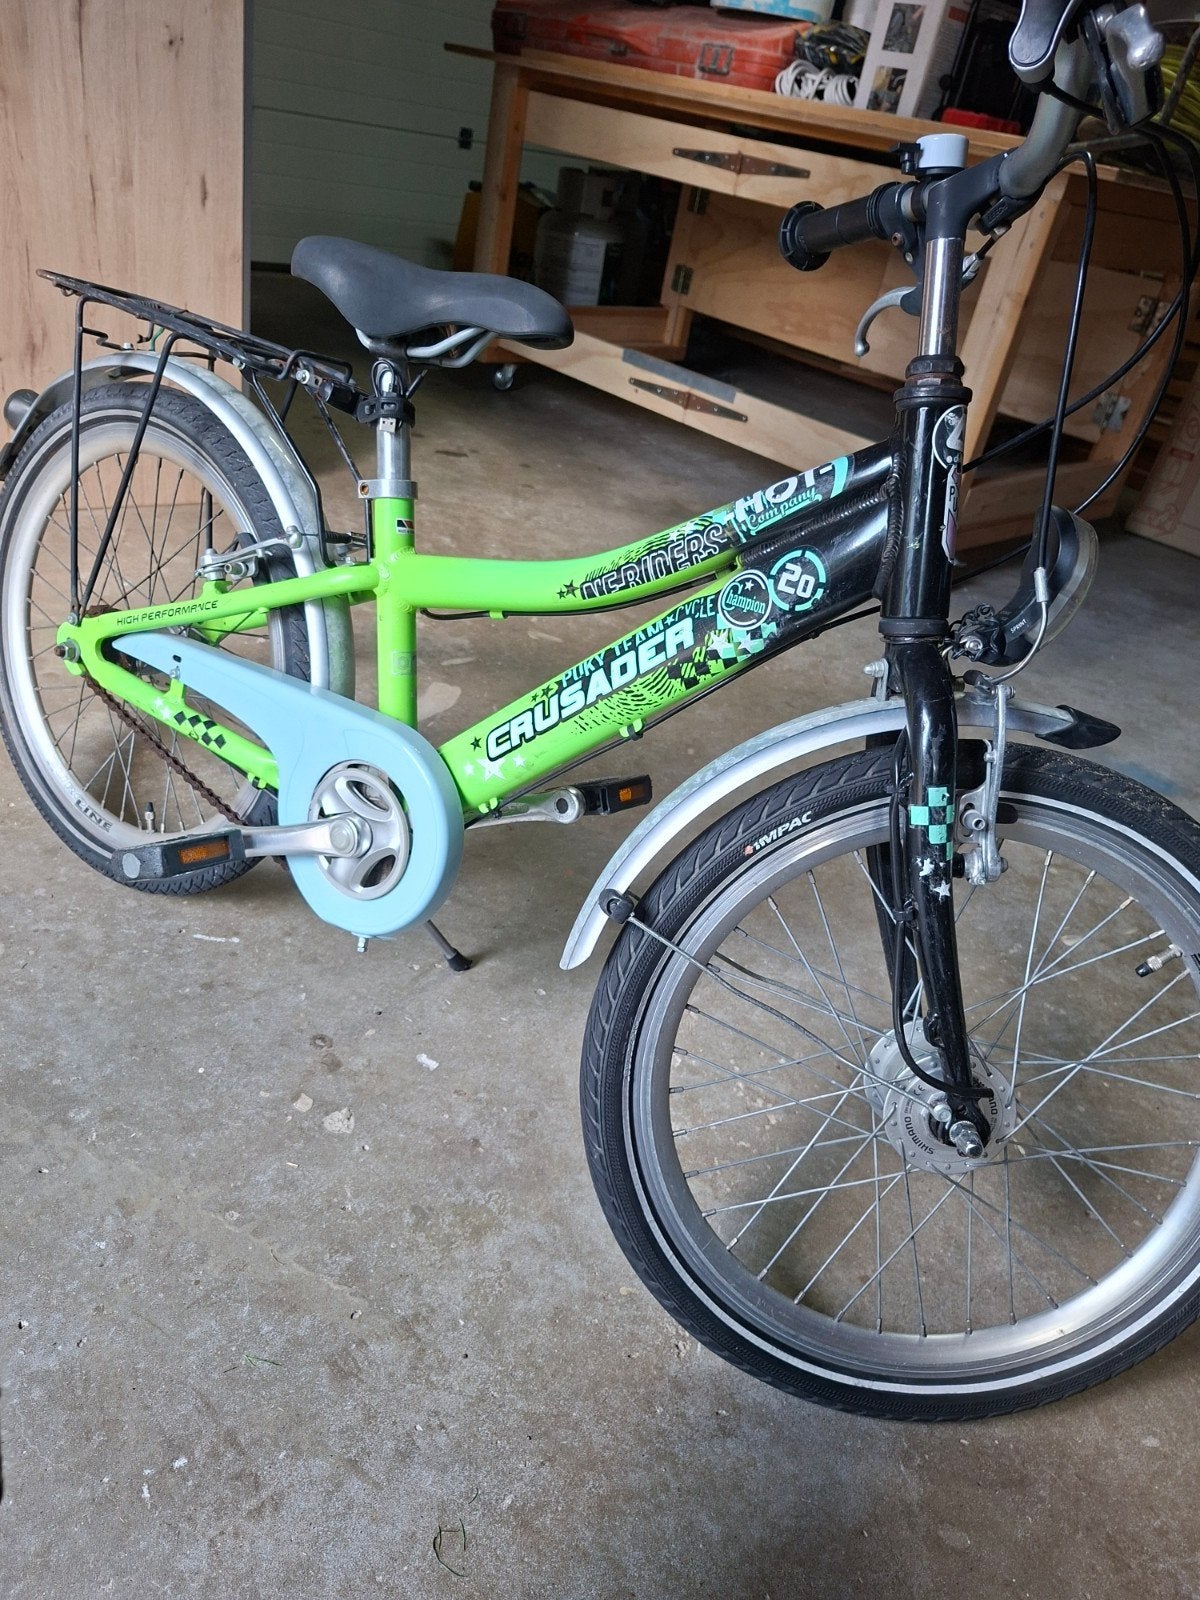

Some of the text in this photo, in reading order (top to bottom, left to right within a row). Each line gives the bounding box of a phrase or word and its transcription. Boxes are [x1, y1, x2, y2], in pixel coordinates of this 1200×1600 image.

[746, 486, 820, 530] Company
[721, 581, 766, 615] Champion
[777, 562, 816, 599] 20
[117, 600, 219, 626] HIGH PERFORMANCE
[487, 616, 695, 760] CRUSADER
[562, 652, 606, 688] PUKY
[904, 1116, 935, 1155] SHIMANO
